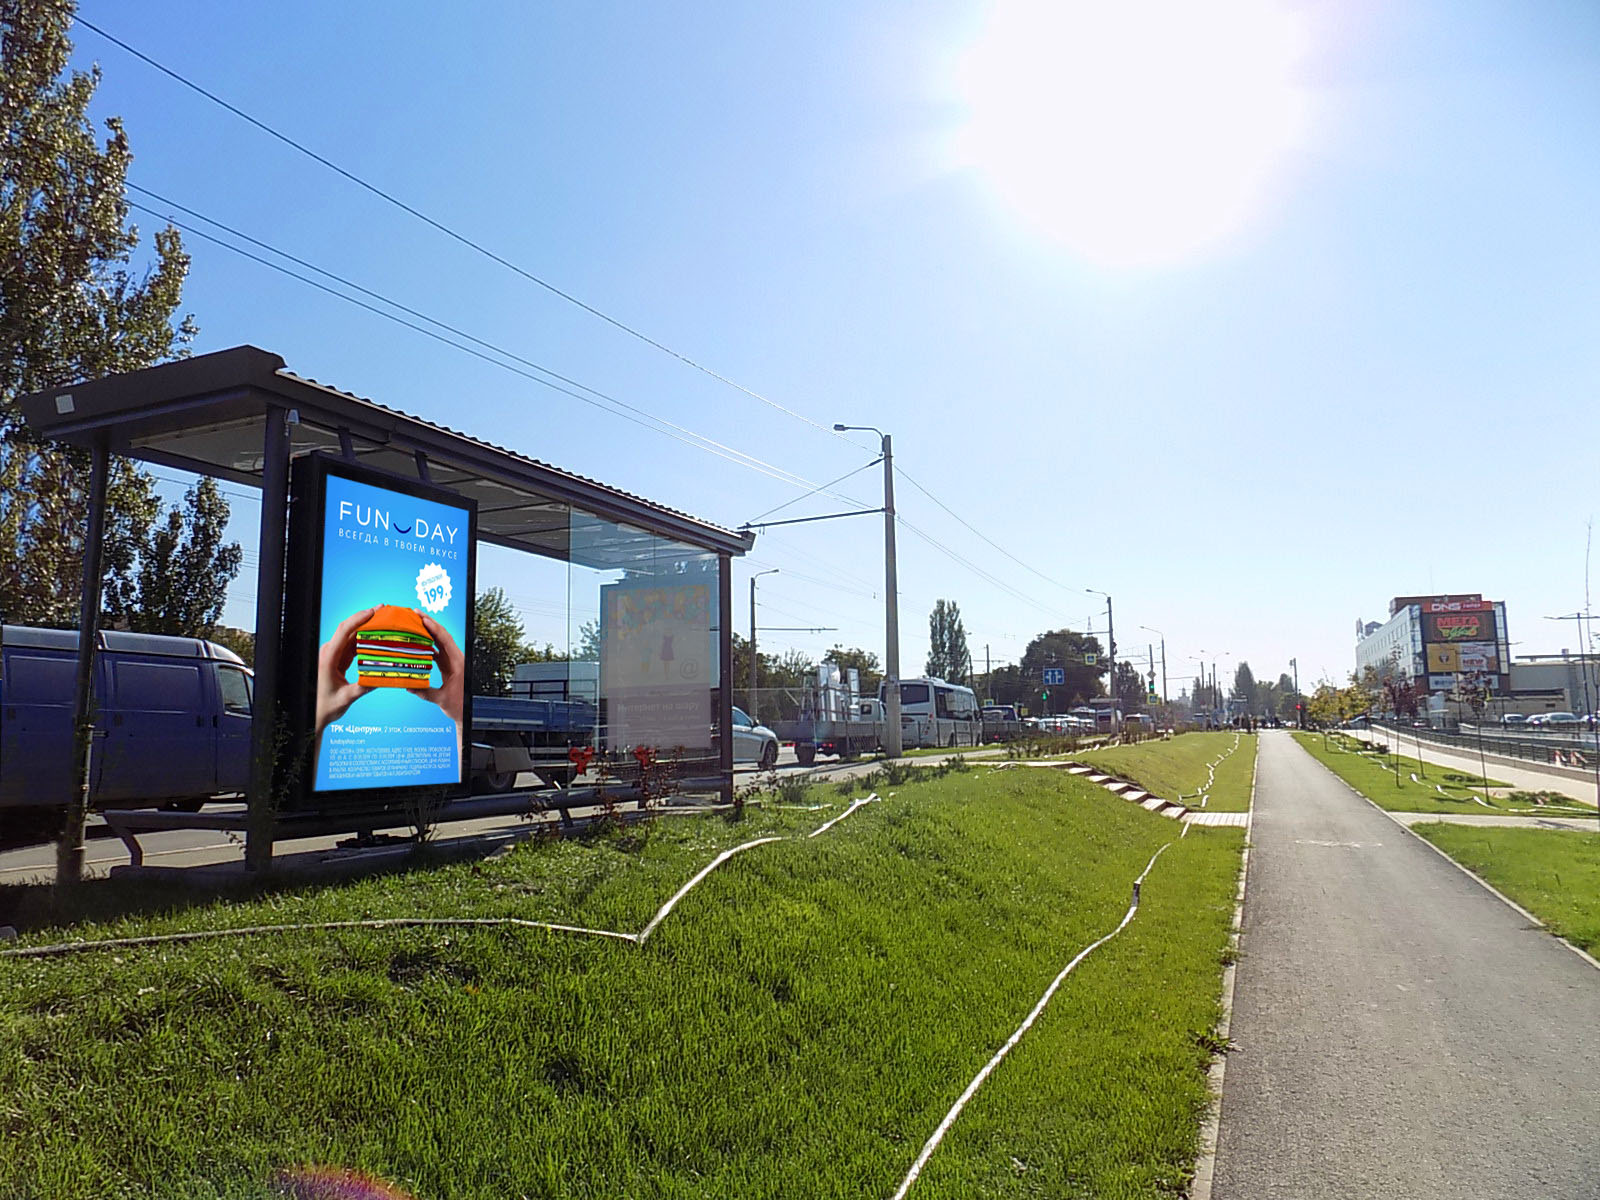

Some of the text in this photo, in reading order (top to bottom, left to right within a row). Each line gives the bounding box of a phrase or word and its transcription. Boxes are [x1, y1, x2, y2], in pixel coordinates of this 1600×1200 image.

[339, 501, 458, 545] FUN DAY
[338, 527, 458, 560] ВСЕГДА В ТВОЕМ ВКУСЕ
[330, 724, 344, 733] ТРК
